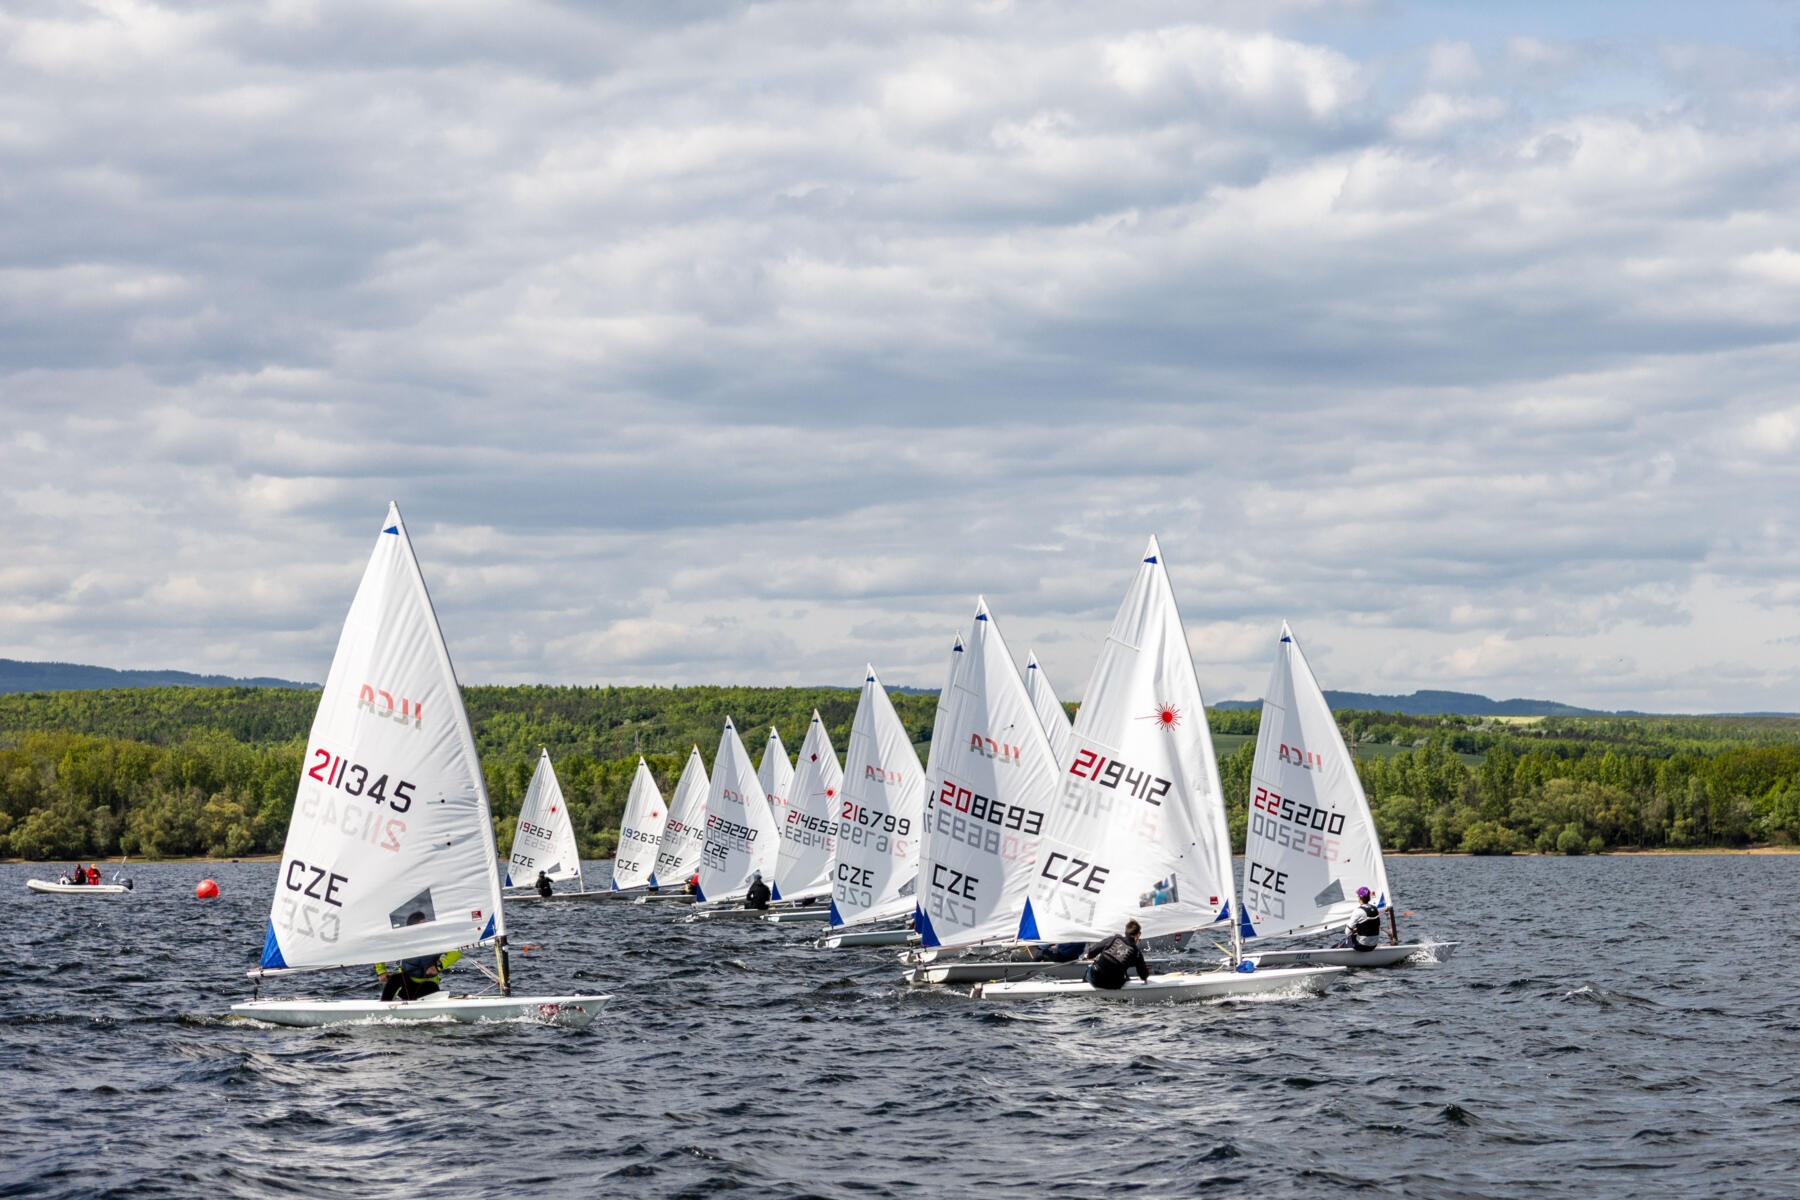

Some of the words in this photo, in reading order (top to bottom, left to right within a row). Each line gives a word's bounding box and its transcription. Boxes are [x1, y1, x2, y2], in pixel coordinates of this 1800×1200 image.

[308, 748, 416, 813] 211345
[1069, 749, 1172, 806] 219412
[787, 810, 838, 835] 214653
[841, 801, 911, 836] 216799
[940, 780, 1044, 835] 208693
[1254, 786, 1346, 835] 225200
[520, 821, 552, 840] 19263
[706, 814, 758, 841] 233290
[512, 853, 535, 868] CZE
[617, 858, 640, 873] CZE
[838, 863, 874, 888] CZE
[1041, 852, 1110, 894] CZE
[1250, 862, 1288, 894] CZE
[286, 859, 349, 907] CZE
[932, 863, 979, 901] CZE
